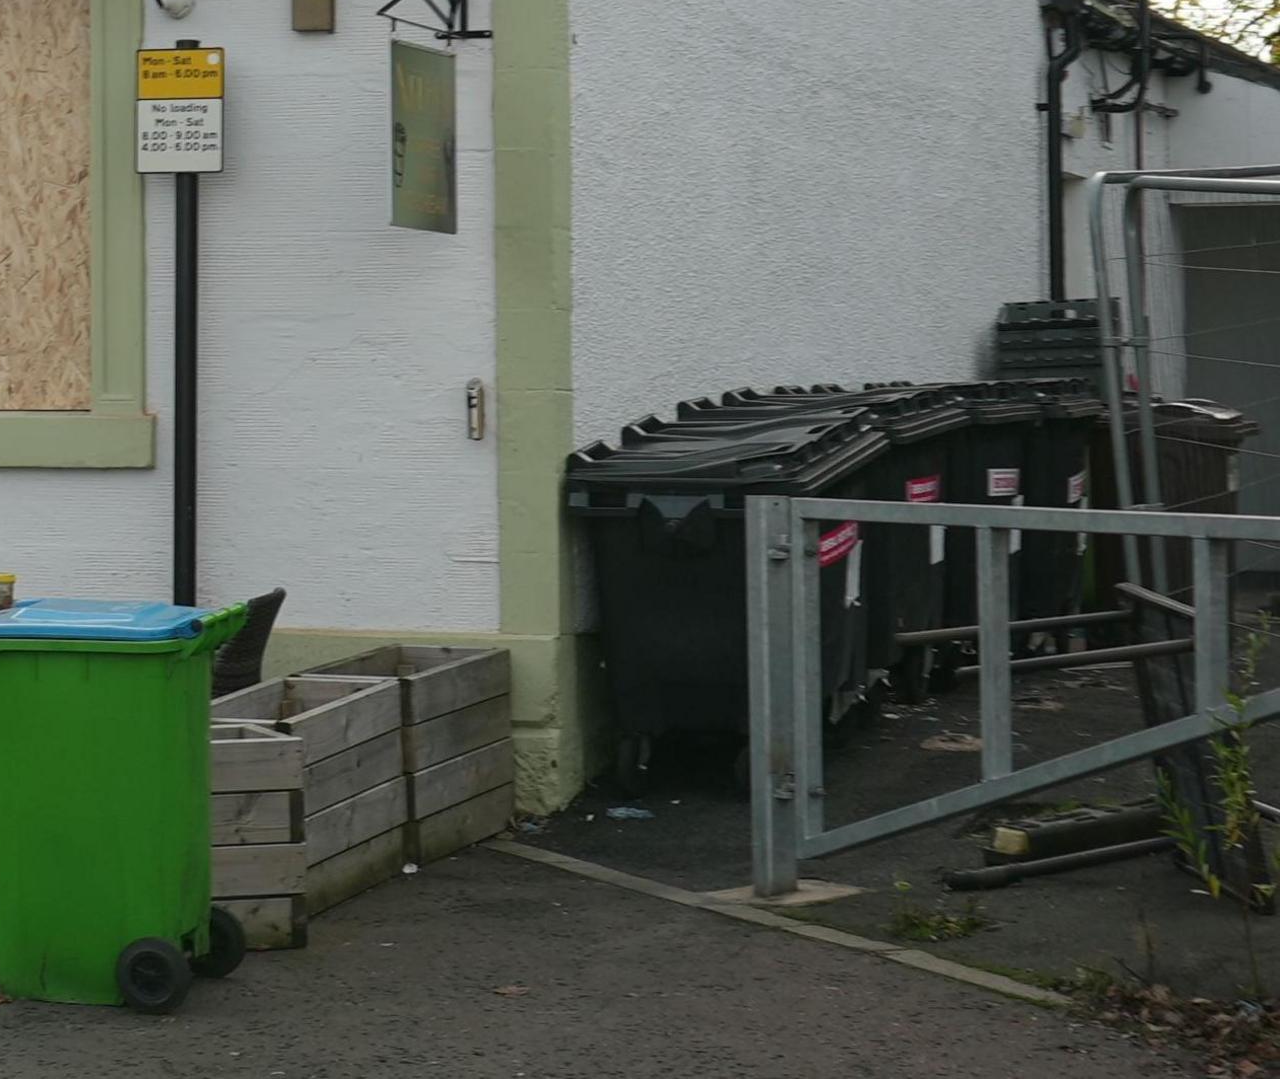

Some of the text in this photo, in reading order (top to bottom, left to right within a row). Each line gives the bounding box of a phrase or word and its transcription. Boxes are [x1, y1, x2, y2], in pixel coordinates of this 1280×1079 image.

[142, 56, 165, 66] Mon
[173, 55, 192, 65] Sat
[152, 103, 208, 114] No loading
[154, 118, 178, 127] Mon
[186, 117, 204, 127] Sat
